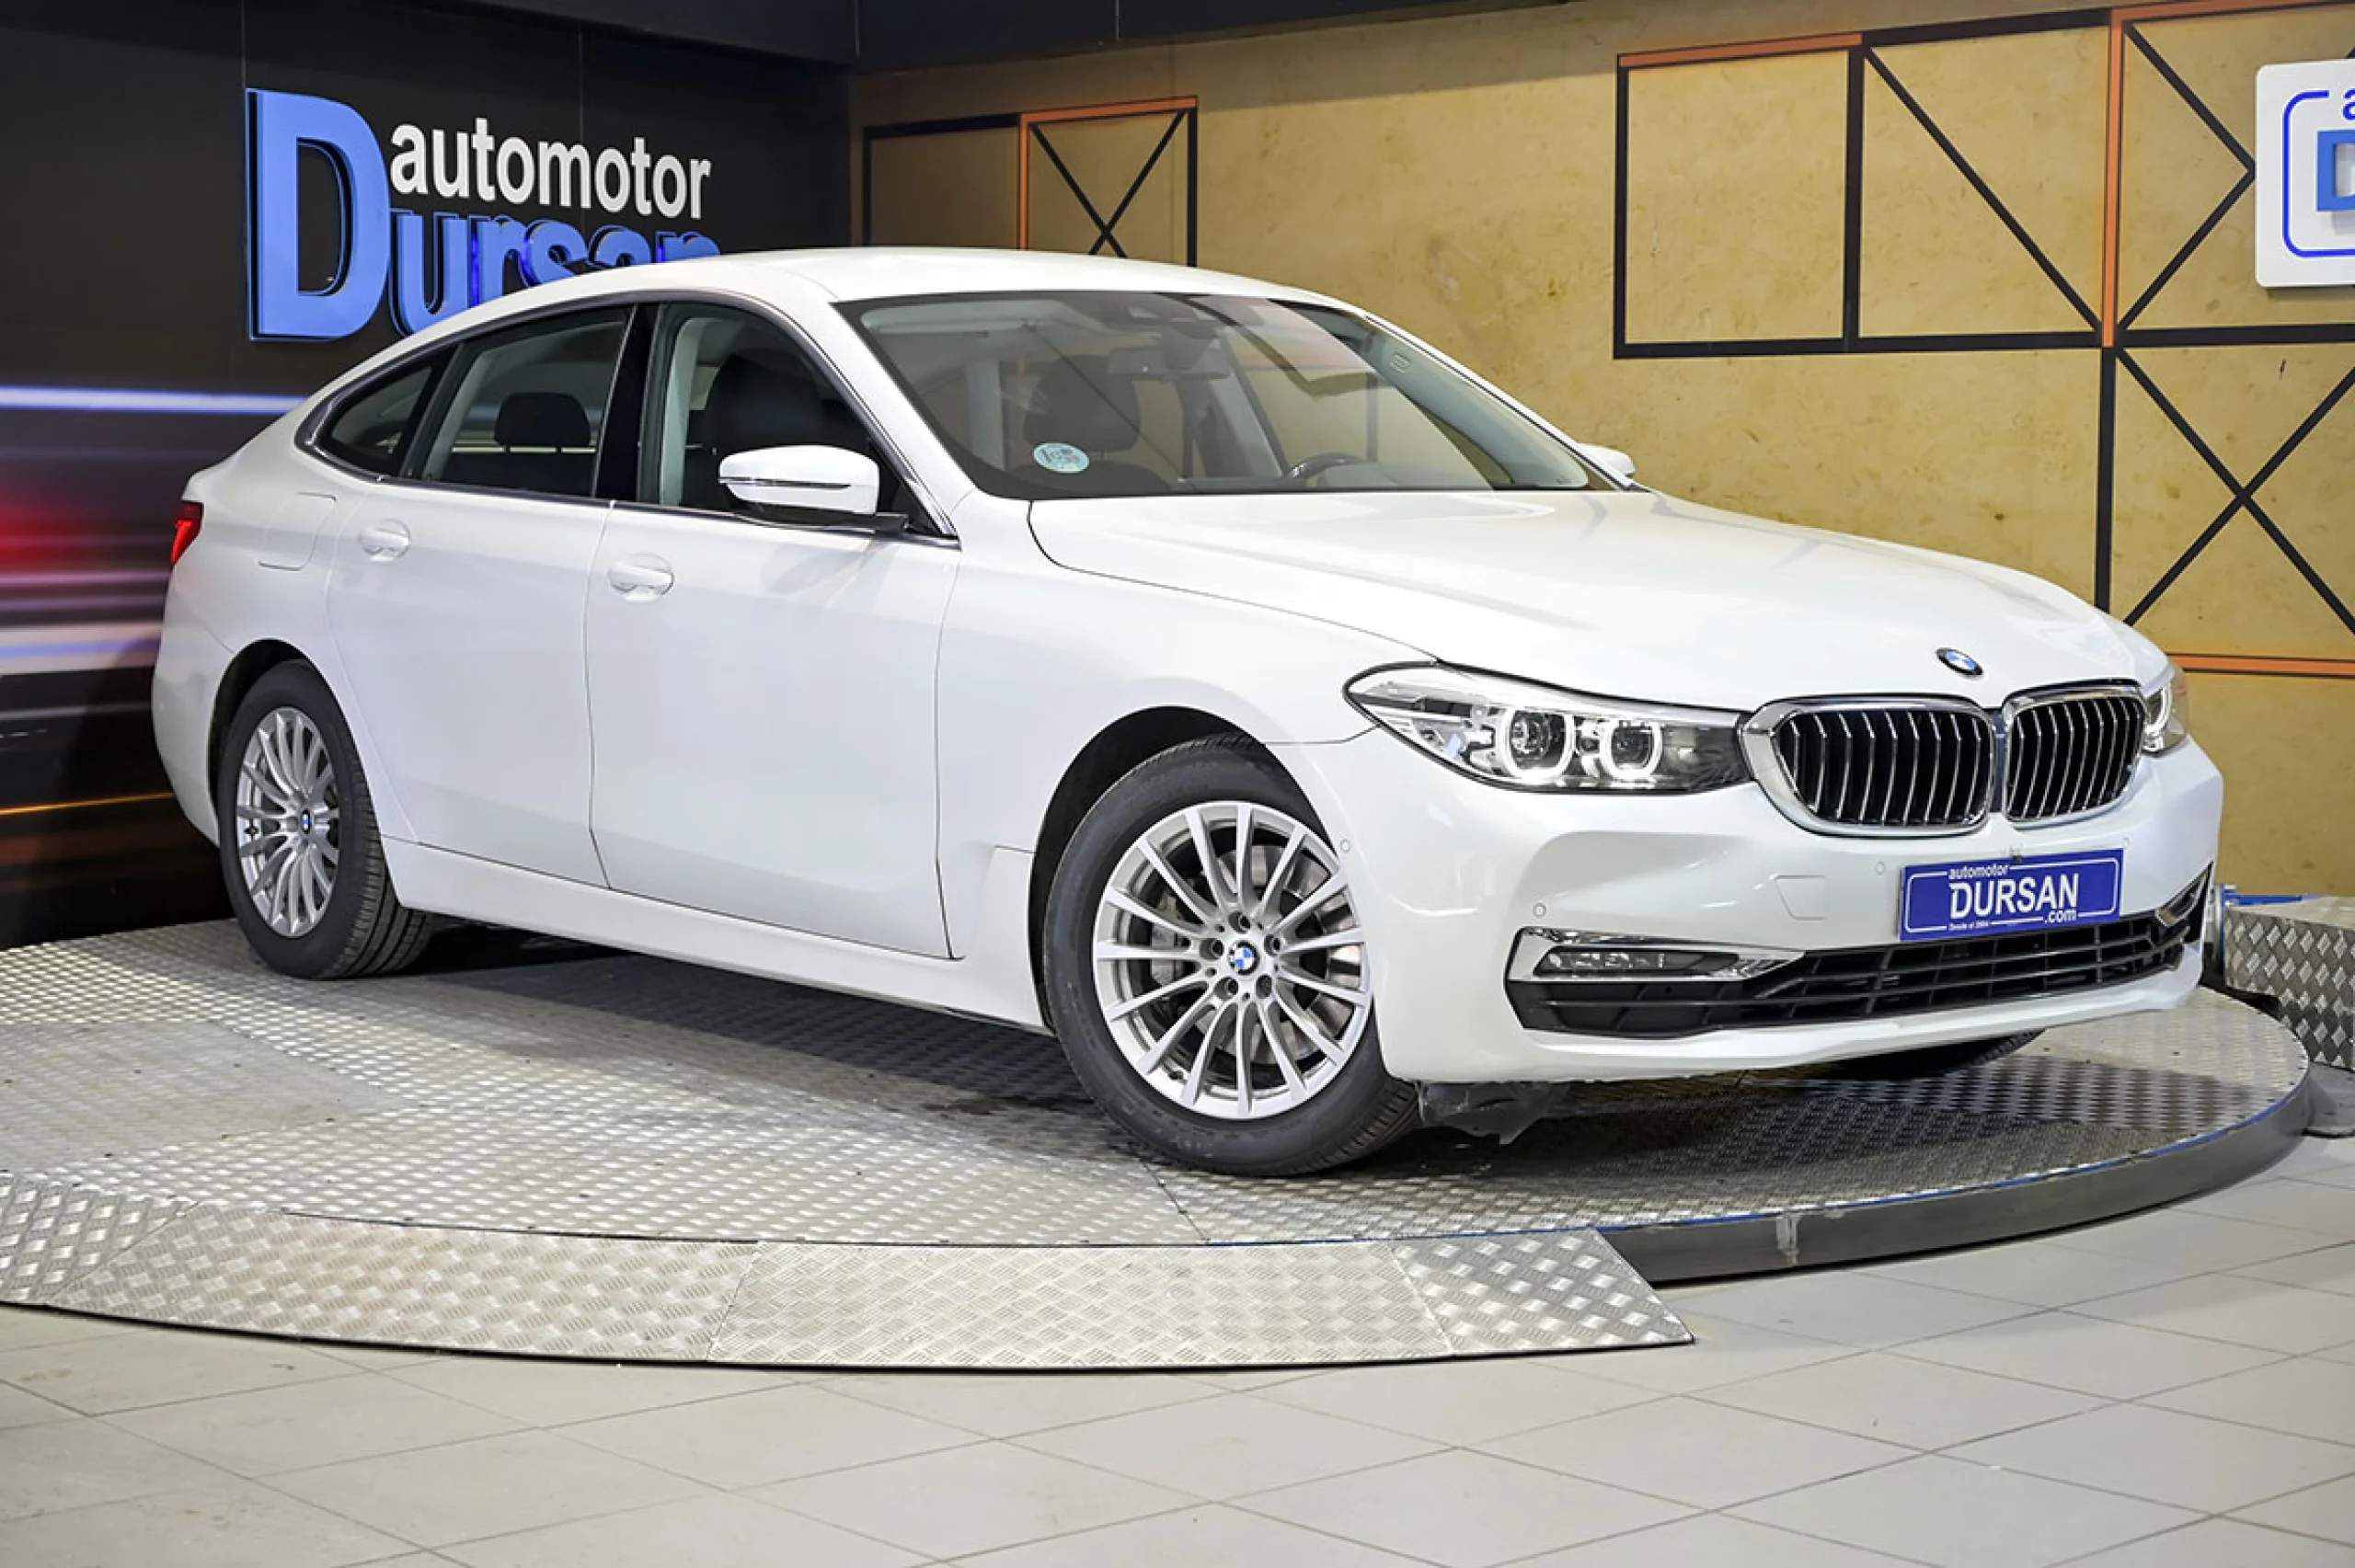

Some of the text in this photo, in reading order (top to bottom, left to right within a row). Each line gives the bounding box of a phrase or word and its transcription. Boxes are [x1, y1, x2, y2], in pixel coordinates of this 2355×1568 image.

[390, 117, 712, 219] automotor
[246, 87, 721, 340] Durs
[1947, 864, 2009, 880] automotor
[1947, 873, 2080, 920] DURSAN
[2044, 909, 2077, 924] .com
